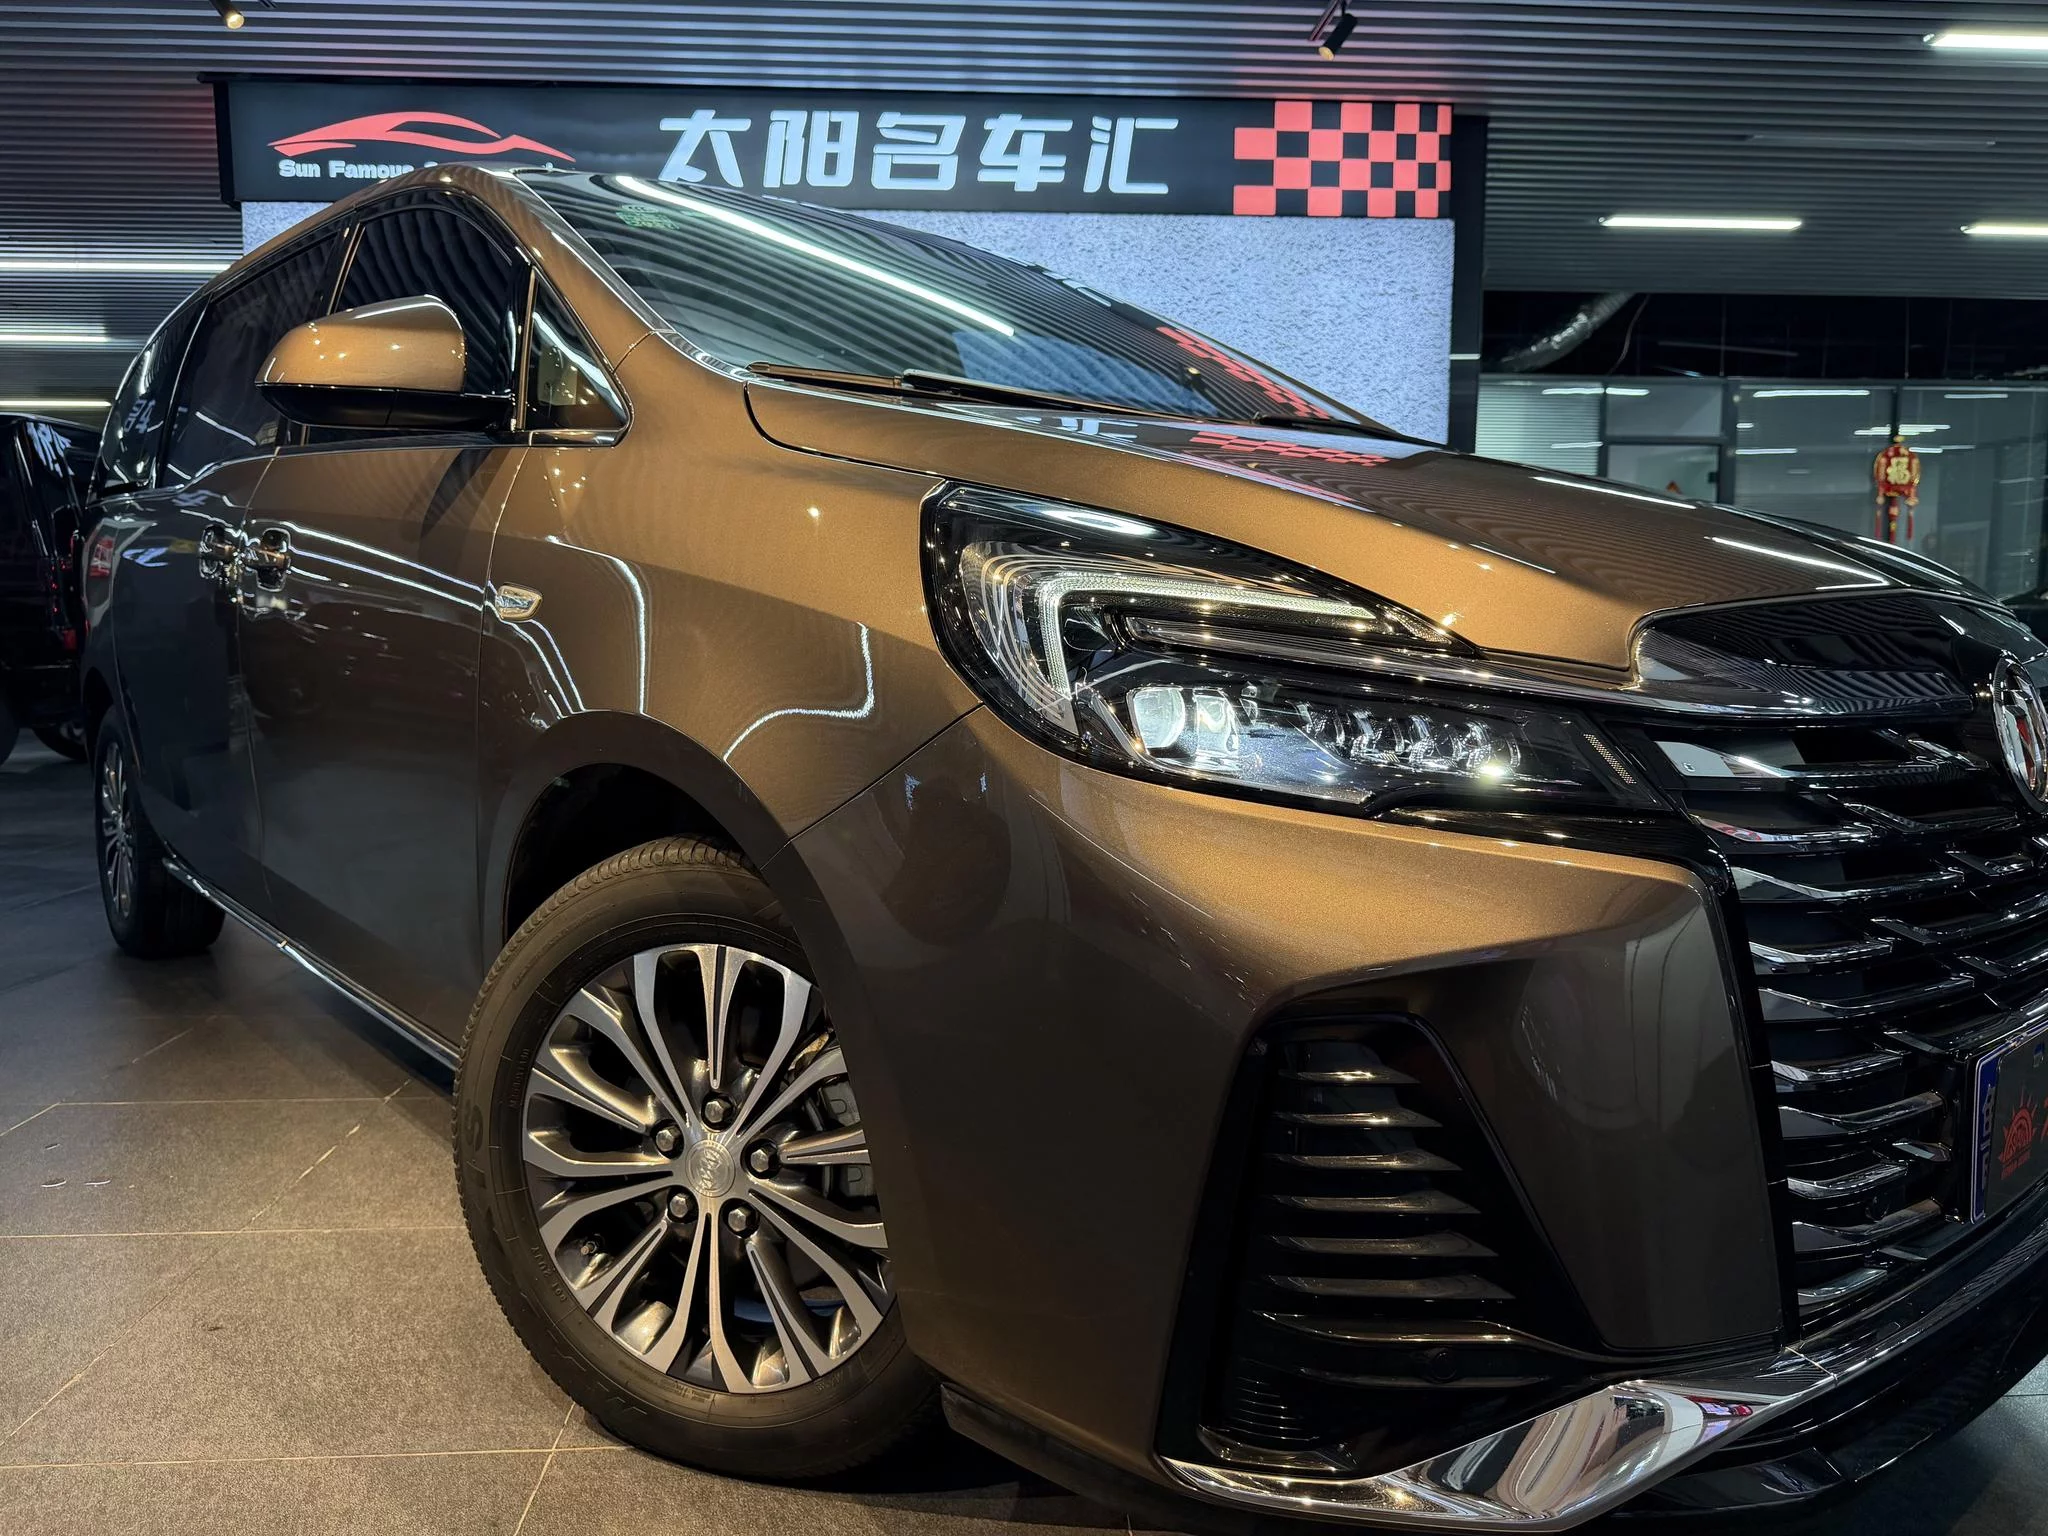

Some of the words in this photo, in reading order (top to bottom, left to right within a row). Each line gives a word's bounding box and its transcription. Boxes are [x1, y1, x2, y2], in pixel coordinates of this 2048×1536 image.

[278, 159, 321, 178] Sun
[659, 108, 1179, 194] 太阳名车汇
